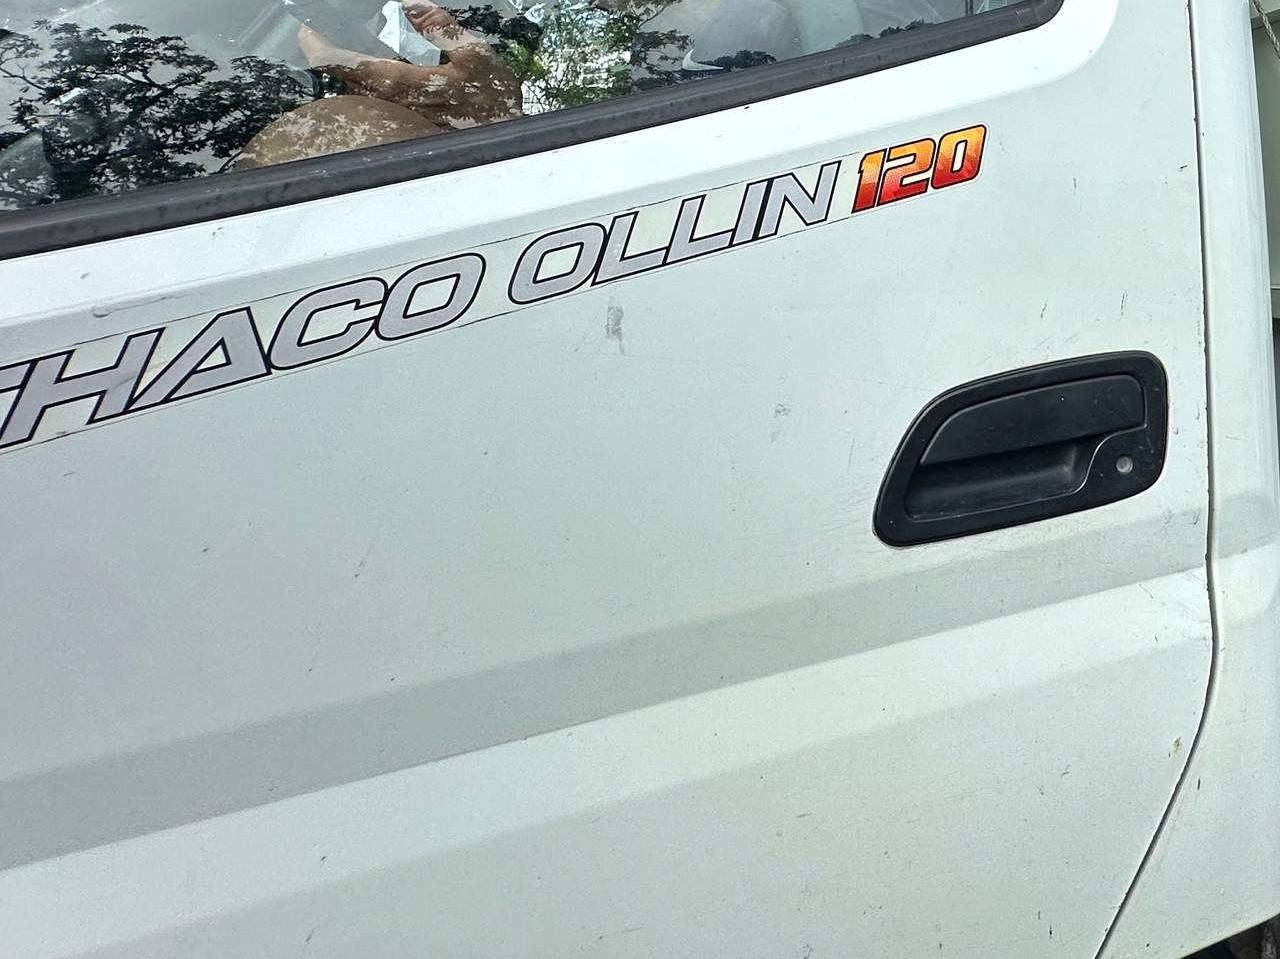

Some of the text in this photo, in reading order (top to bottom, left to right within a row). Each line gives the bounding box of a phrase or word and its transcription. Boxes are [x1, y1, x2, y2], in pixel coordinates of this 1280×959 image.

[0, 123, 989, 449] HACO OLLIN 120
